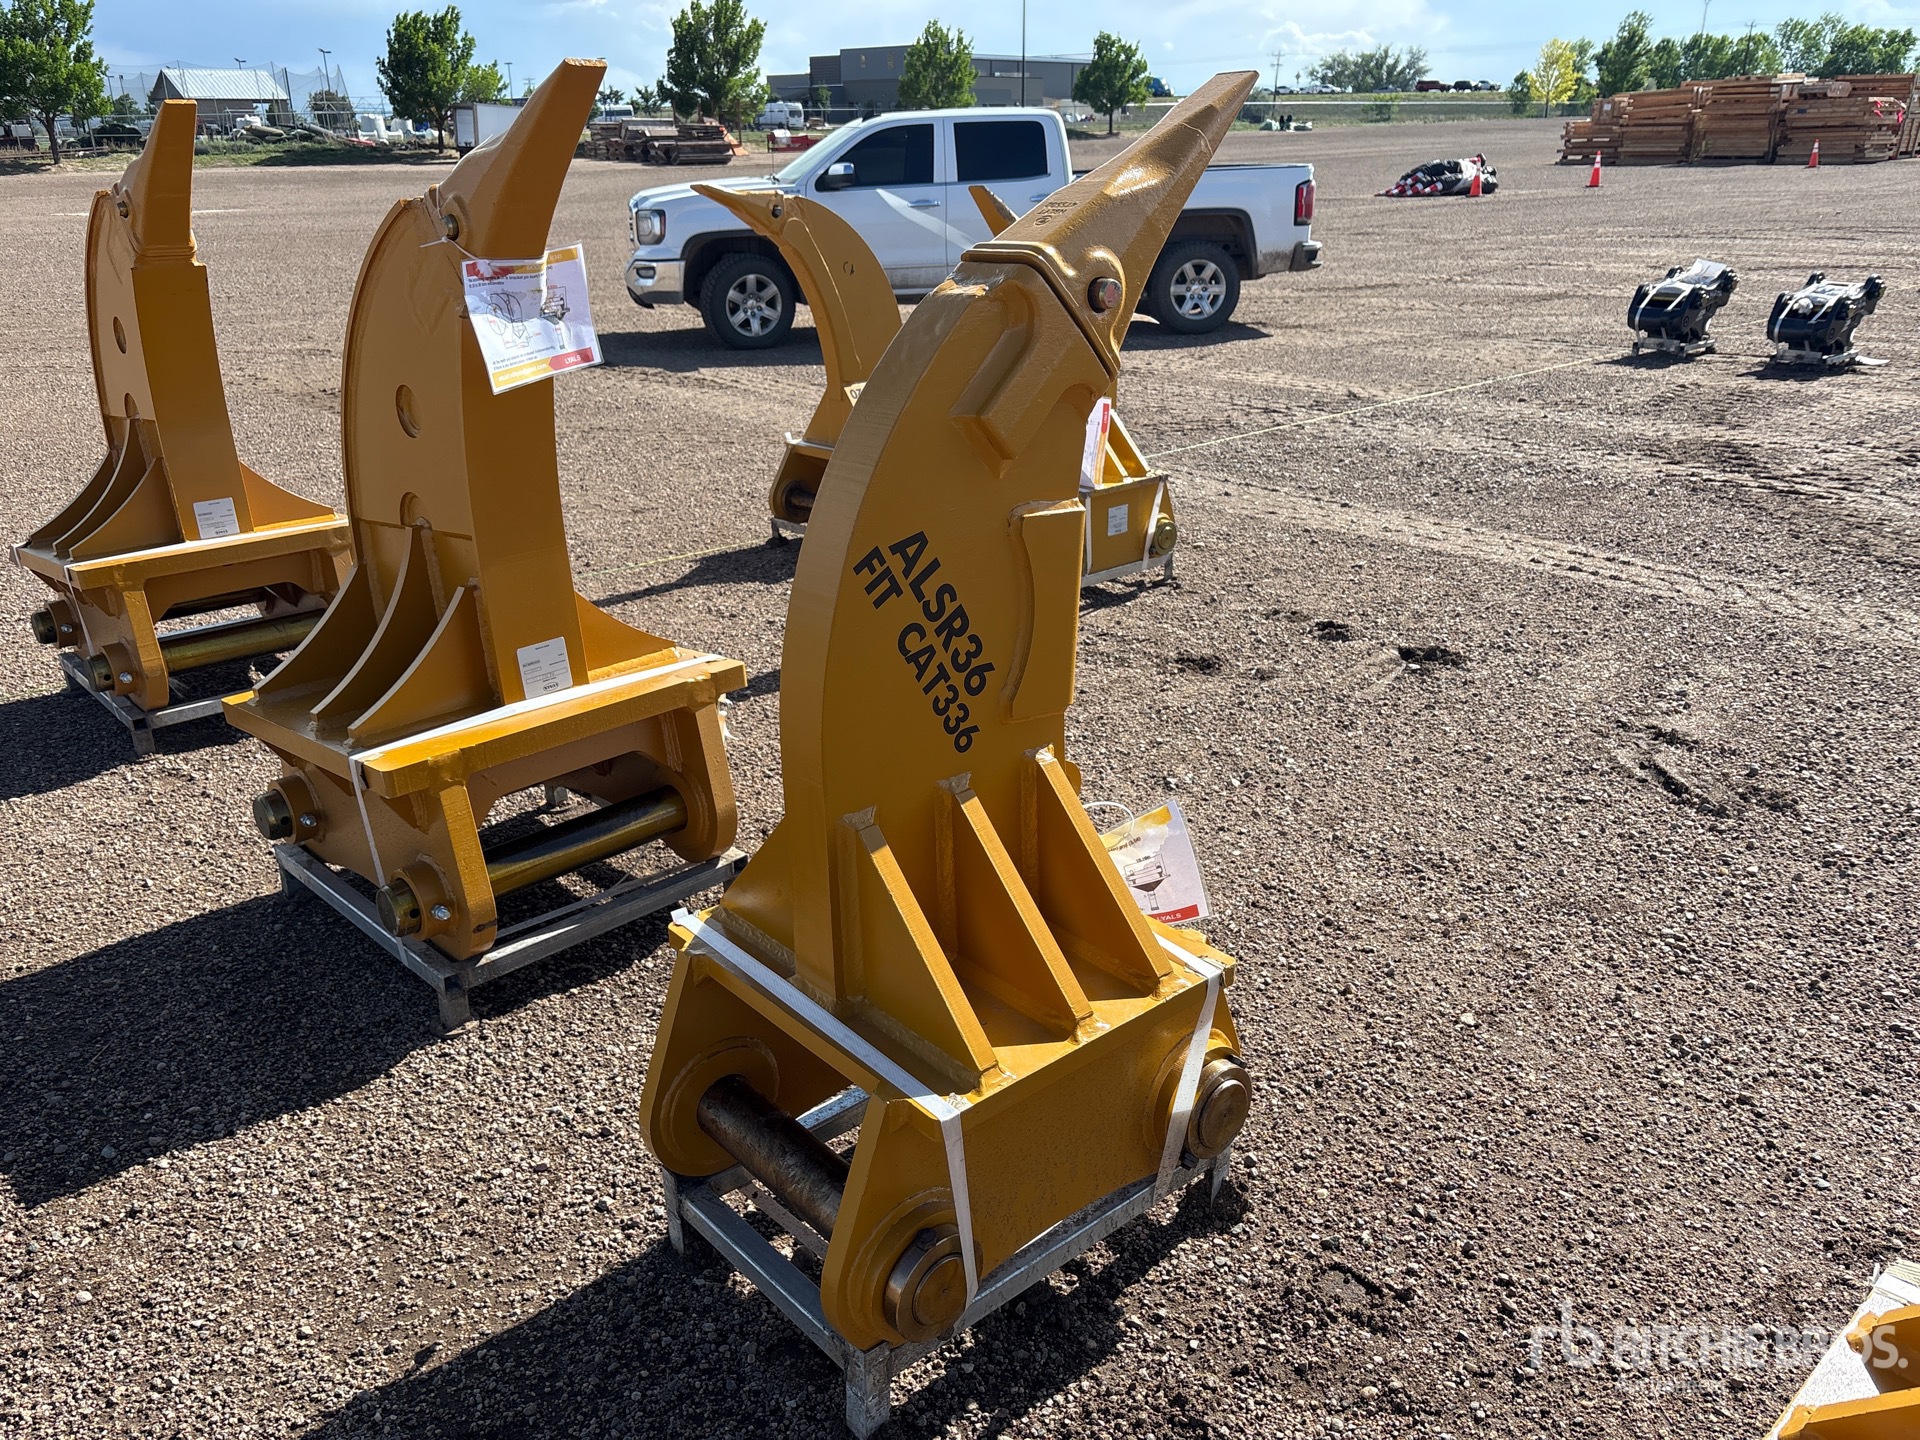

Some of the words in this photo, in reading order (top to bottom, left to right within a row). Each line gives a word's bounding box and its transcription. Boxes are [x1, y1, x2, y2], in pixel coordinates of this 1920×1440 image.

[564, 354, 582, 364] LYALS
[852, 545, 904, 610] FIT
[897, 622, 981, 754] CAT336
[888, 530, 996, 697] ALSR36
[1157, 912, 1182, 921] LYALS
